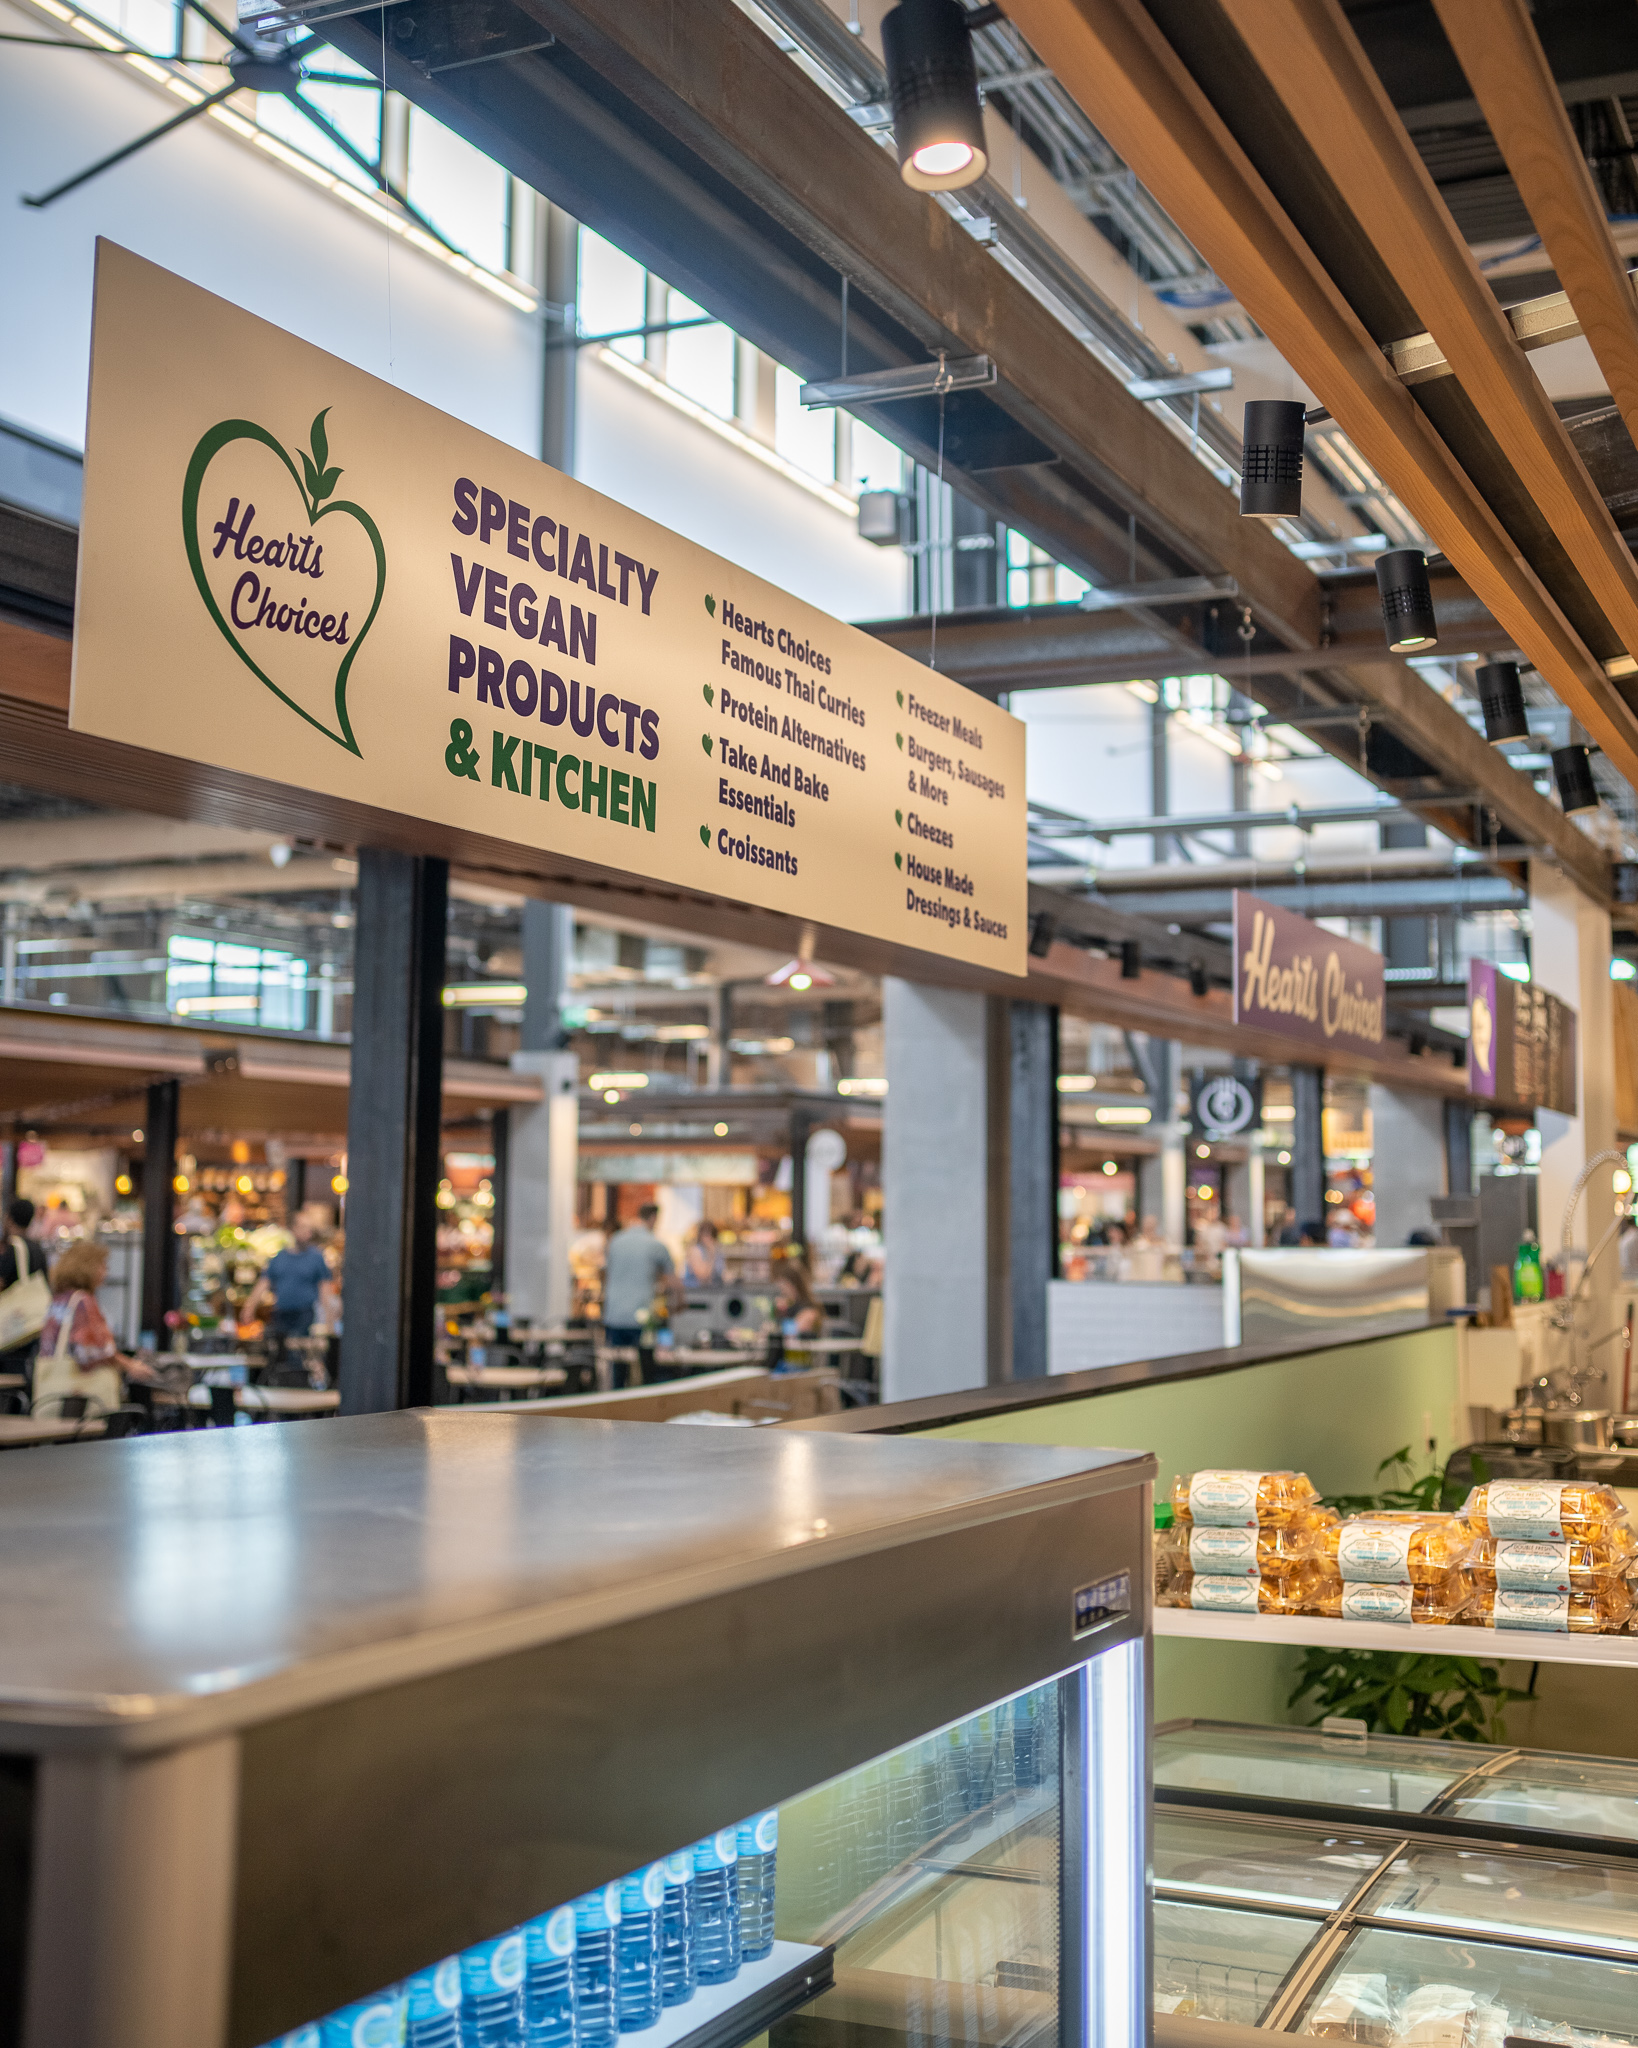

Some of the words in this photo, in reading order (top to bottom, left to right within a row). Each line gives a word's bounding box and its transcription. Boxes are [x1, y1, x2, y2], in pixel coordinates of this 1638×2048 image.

[213, 497, 325, 579] Hearts
[451, 477, 660, 616] SPECIALTY
[230, 570, 351, 646] Choices
[449, 552, 598, 667] VEGAN
[722, 599, 774, 648] Hearts
[777, 628, 832, 676] Choices
[447, 633, 660, 761] PRODUCTS
[721, 638, 782, 694] Famous
[785, 668, 815, 704] Thai
[817, 685, 866, 728] Curries
[720, 687, 778, 736] Protein
[780, 715, 866, 773] Alternatives
[908, 693, 950, 734] Freezer
[952, 715, 983, 751] Meals
[444, 717, 482, 783] &
[491, 730, 657, 834] KITCHEN
[718, 776, 796, 829] Essentials
[719, 736, 758, 777] Take
[760, 754, 791, 788] And
[794, 765, 830, 803] Bake
[907, 770, 917, 793] &
[919, 775, 948, 806] More
[908, 735, 955, 781] Burgers,
[957, 759, 1006, 800] Sausages
[717, 827, 798, 876] Croissants
[907, 812, 954, 849] Cheezes
[906, 853, 943, 887] House
[944, 866, 974, 897] Made
[906, 887, 961, 929] Dressings
[963, 906, 972, 929] &
[973, 910, 1008, 940] Sauces
[1243, 909, 1319, 1023] Hearts
